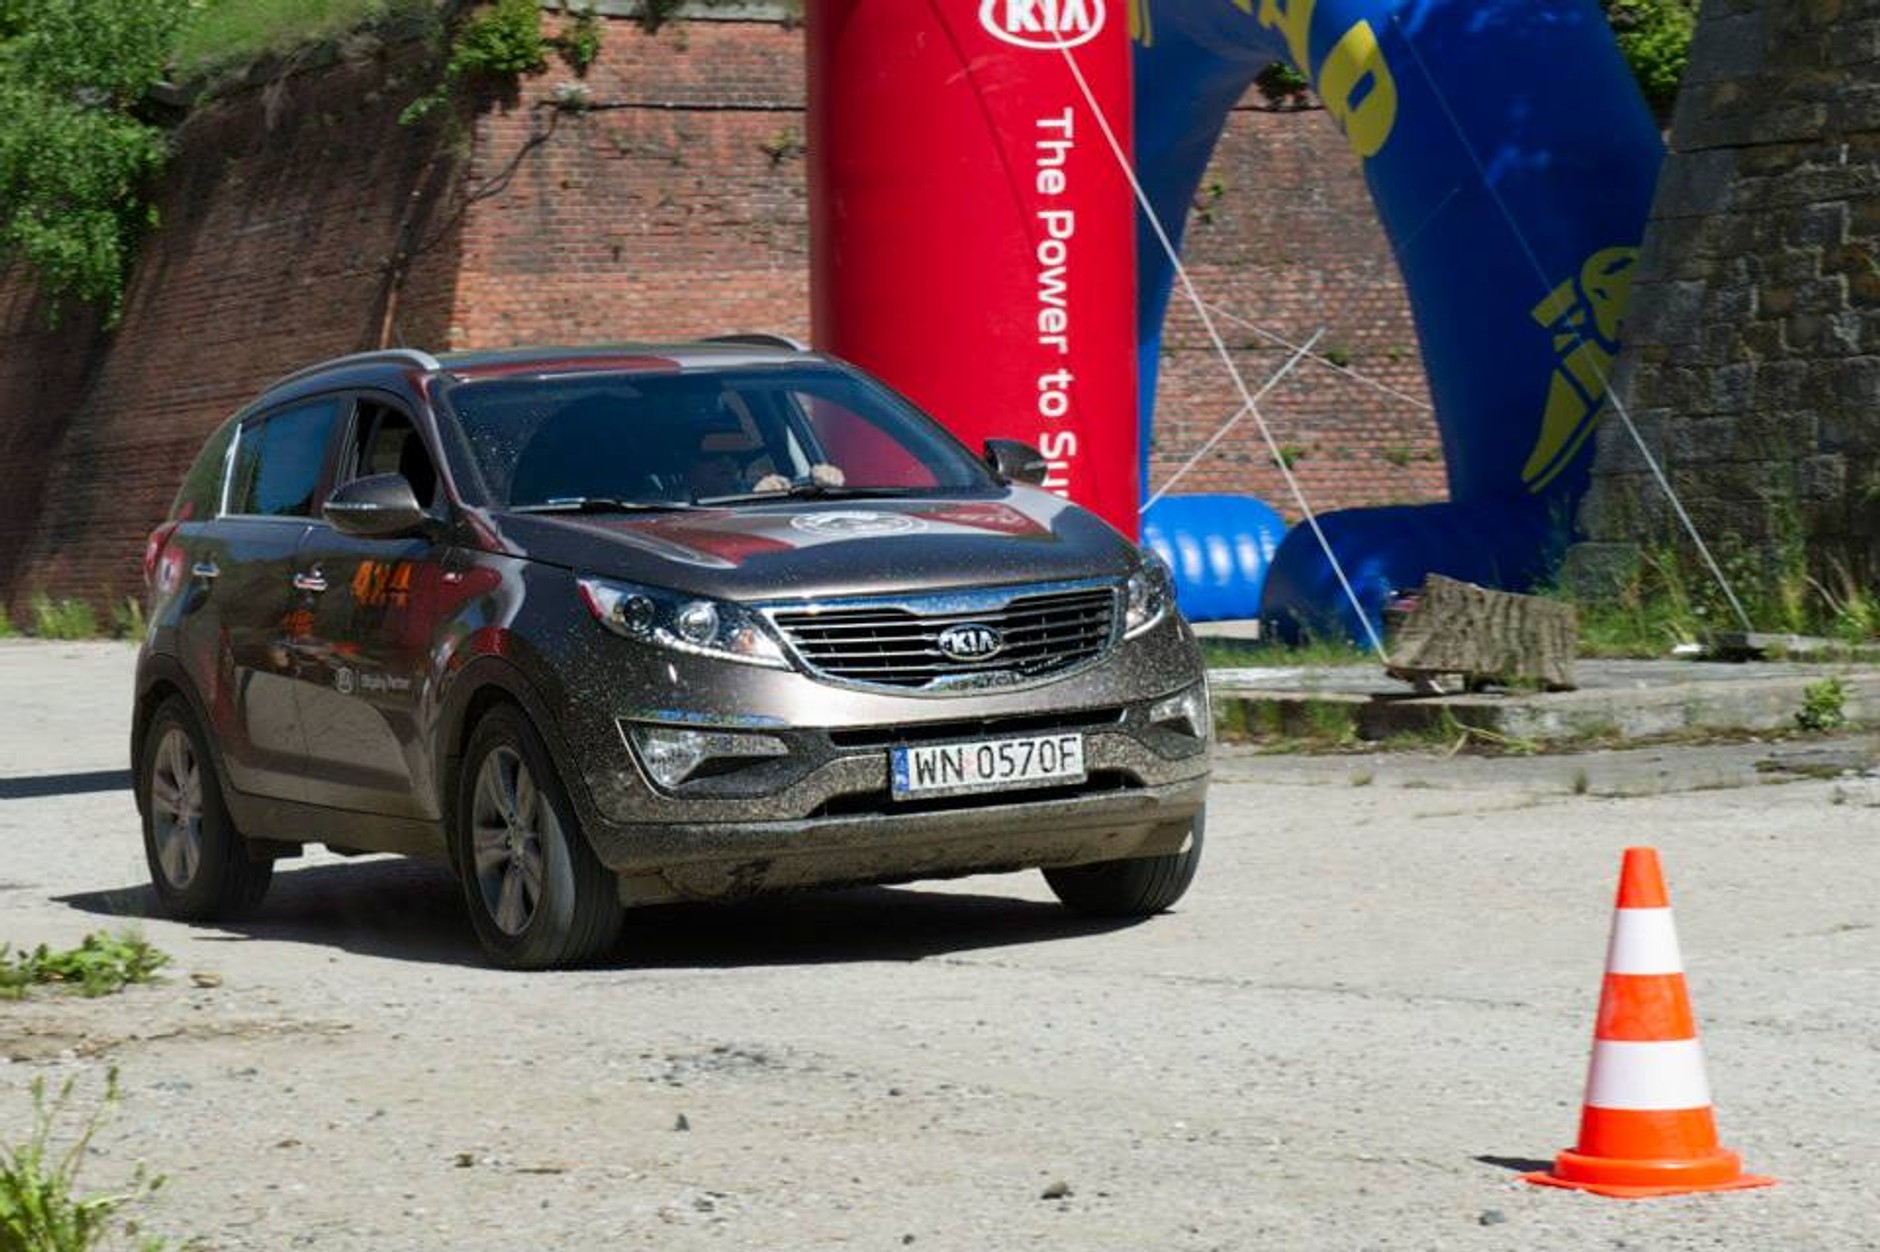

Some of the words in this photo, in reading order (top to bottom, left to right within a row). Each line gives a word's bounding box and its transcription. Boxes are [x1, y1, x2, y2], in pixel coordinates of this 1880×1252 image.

[1006, 0, 1090, 32] KIA
[1036, 107, 1074, 195] The
[1036, 210, 1075, 354] Power
[1038, 368, 1075, 417] to
[952, 630, 995, 652] KIA
[914, 747, 964, 785] WN
[976, 737, 1078, 780] 0570F
